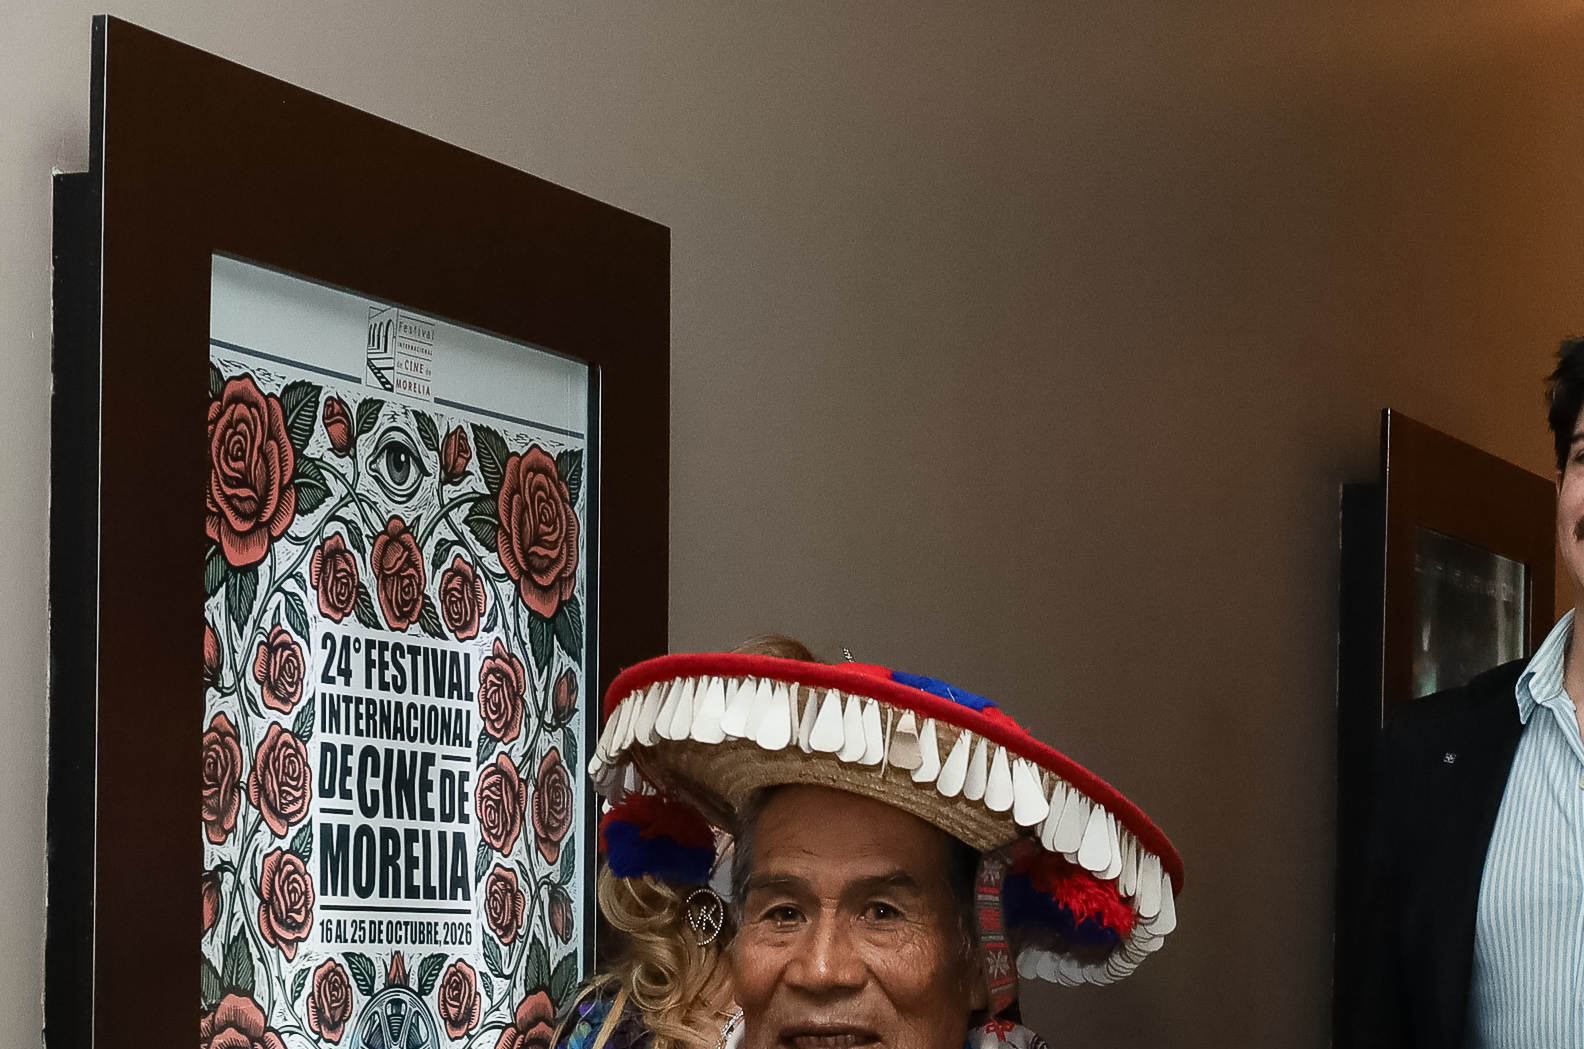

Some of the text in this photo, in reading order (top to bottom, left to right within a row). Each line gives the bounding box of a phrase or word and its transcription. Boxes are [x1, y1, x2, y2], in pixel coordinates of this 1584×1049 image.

[398, 321, 435, 341] Festival
[395, 378, 431, 396] MORELIA
[404, 359, 424, 374] CINE
[364, 638, 474, 702] FESTIVAL
[320, 692, 472, 748] INTERNACIONAL
[318, 741, 470, 825] DE CINE DE
[319, 822, 472, 901] MORELIA
[319, 919, 472, 947] 16 AL 25 DE OCTUBRE, 2026
